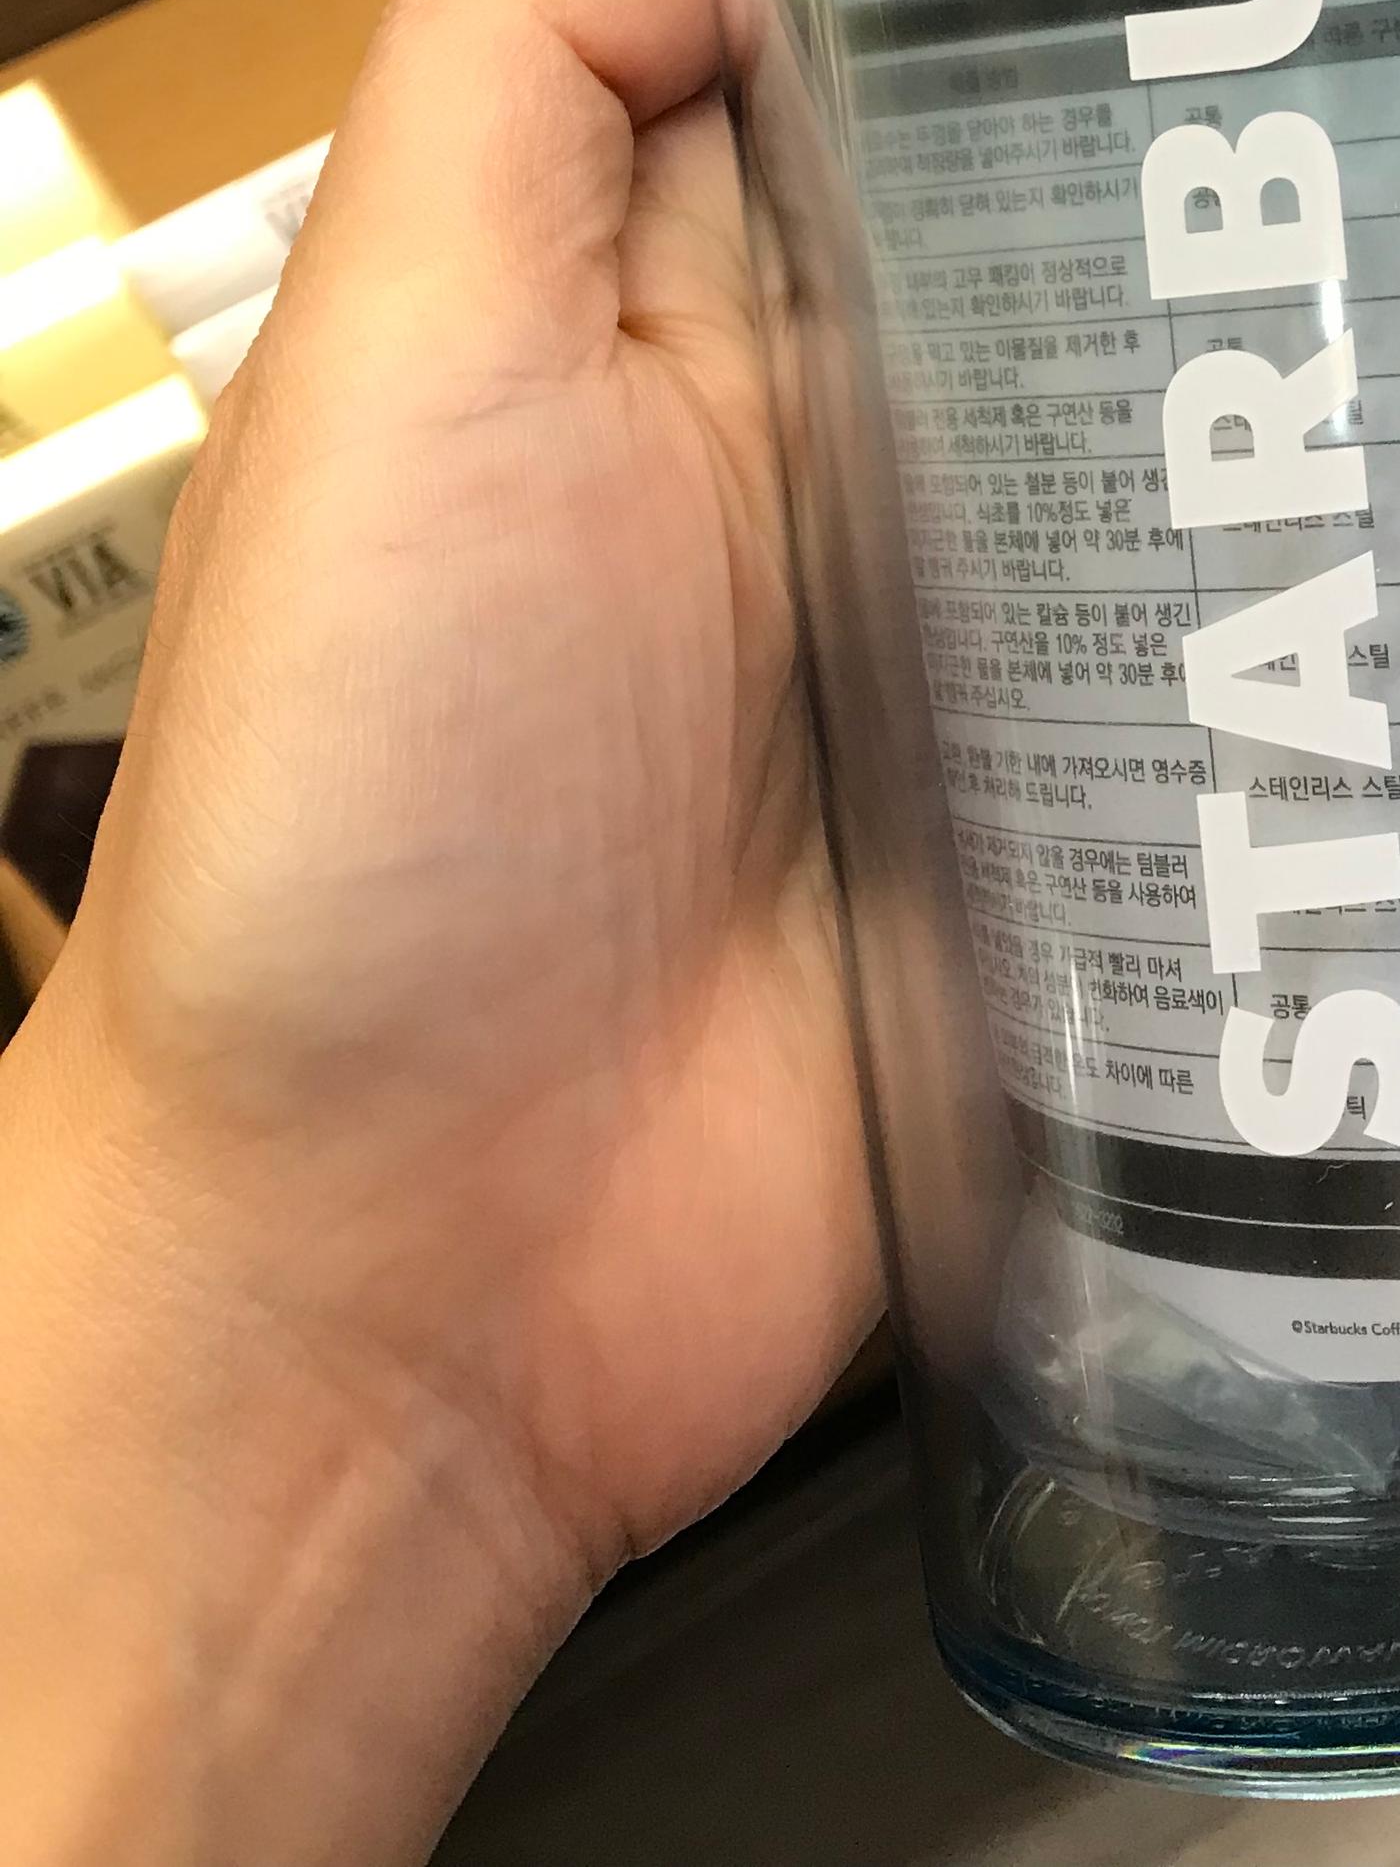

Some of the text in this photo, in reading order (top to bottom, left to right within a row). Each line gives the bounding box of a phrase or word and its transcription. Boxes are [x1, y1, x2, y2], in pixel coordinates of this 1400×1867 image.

[1022, 111, 1054, 135] 하는
[1061, 103, 1112, 130] 경우를
[978, 138, 1057, 169] 넣어주시기
[1062, 130, 1135, 158] 바랍니다.
[995, 187, 1045, 214] 있는지
[1050, 177, 1137, 207] 확인하시기
[954, 263, 983, 287] 고무
[988, 261, 1035, 286] 패킹이
[1041, 255, 1128, 285] 정상적으로
[970, 287, 1050, 316] 확인하시기
[1054, 284, 1129, 312] 바랍니다.
[960, 339, 991, 364] 있는
[996, 336, 1058, 362] 이물질을
[1065, 331, 1117, 358] 제거한
[1122, 330, 1141, 355] 후
[958, 366, 1025, 390] 바랍니다.
[963, 402, 1007, 427] 세척제
[1011, 402, 1041, 427] 혹은
[1046, 400, 1094, 426] 구연산
[1099, 398, 1133, 425] 등을
[1024, 428, 1093, 456] 바랍니다.
[987, 471, 1018, 496] 있는
[1024, 471, 1056, 495] 철분
[1063, 470, 1094, 495] 등이
[1100, 468, 1135, 494] 붙어
[977, 499, 1020, 525] 식초를
[1095, 496, 1132, 524] 넣은
[994, 528, 1039, 554] 본체에
[1047, 529, 1078, 554] 넣어
[1084, 529, 1101, 553] 약
[1106, 528, 1141, 552] 30분
[1147, 527, 1184, 552] 후에
[956, 557, 997, 580] 주시기
[1001, 557, 1070, 582] 바랍니다.
[1001, 602, 1032, 629] 있는
[1036, 601, 1069, 629] 칼슘
[1074, 602, 1107, 629] 등이
[1112, 601, 1148, 629] 붙어
[1154, 601, 1192, 629] 생긴
[990, 628, 1049, 656] 구연산을
[1055, 631, 1088, 656] 10%
[1092, 632, 1126, 657] 정도
[1132, 632, 1168, 659] 넣은
[1348, 642, 1391, 671] 스틸
[1006, 658, 1052, 684] 본체에
[1057, 661, 1090, 687] 넣어
[1096, 661, 1113, 686] 약
[1117, 661, 1154, 687] 30분
[970, 685, 1031, 712] 주십시오.
[996, 749, 1022, 776] 기한
[1026, 754, 1057, 778] 내에
[1062, 755, 1146, 784] 가져오시면
[1151, 758, 1207, 787] 영수증
[983, 776, 1022, 802] 처리해
[1025, 783, 1092, 811] 드립니다.
[1247, 774, 1354, 803] 스테인리스
[1036, 843, 1066, 872] 않을
[1068, 847, 1132, 877] 경우에는
[1135, 851, 1190, 880] 텀블러
[1015, 866, 1043, 895] 혹은
[1045, 872, 1088, 902] 구연산
[1091, 878, 1123, 905] 등을
[1128, 881, 1198, 911] 사용하여
[1059, 946, 1104, 974] 가급적
[1108, 951, 1142, 977] 빨리
[1147, 955, 1183, 983] 마셔
[1153, 985, 1225, 1016] 음료색이
[1105, 1059, 1153, 1091] 차이에
[1158, 1067, 1195, 1096] 따른
